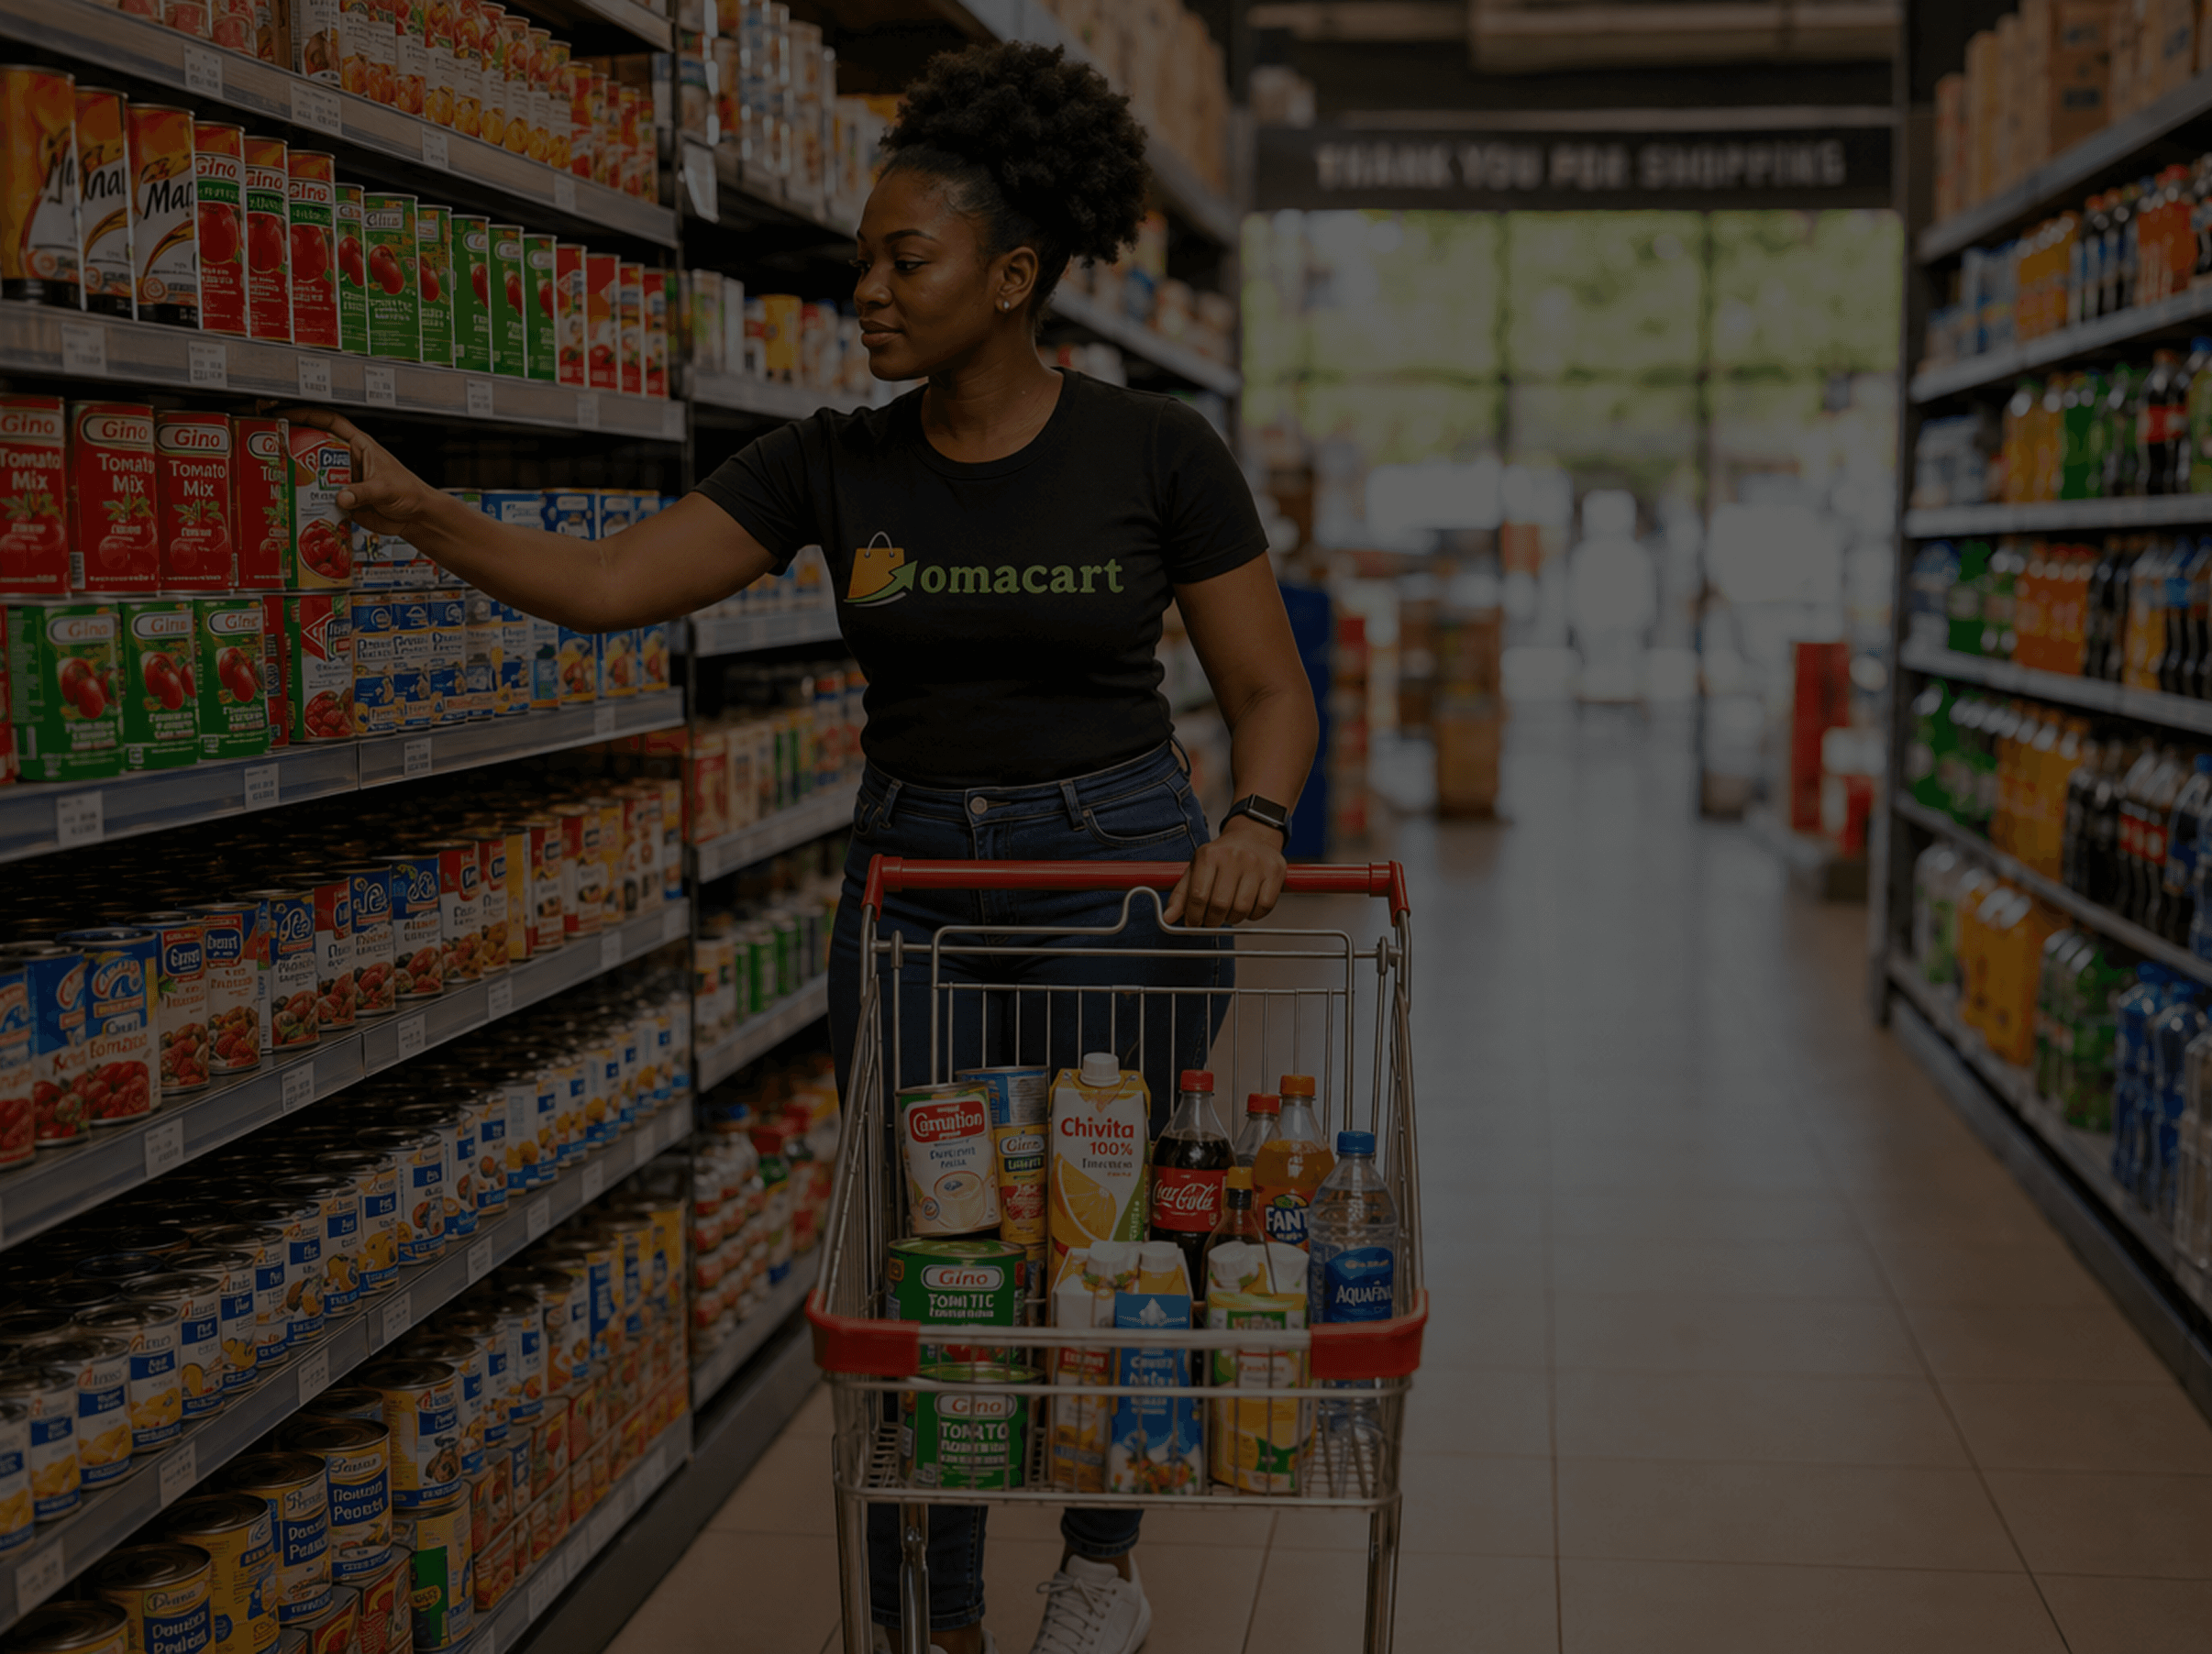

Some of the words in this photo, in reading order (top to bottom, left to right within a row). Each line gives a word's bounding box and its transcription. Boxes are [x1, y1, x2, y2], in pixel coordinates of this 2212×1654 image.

[1459, 142, 1544, 189] YOU
[1, 413, 55, 436] Gino
[102, 420, 148, 442] Gino
[174, 428, 221, 448] Gino
[169, 459, 227, 480] Tomato
[12, 470, 49, 491] Mix
[112, 474, 145, 494] Mix
[183, 480, 215, 498] Mix
[1060, 1117, 1134, 1140] Chivita
[1089, 1141, 1133, 1156] 100%
[938, 1269, 989, 1285] Gino
[952, 1397, 1002, 1413] Gno
